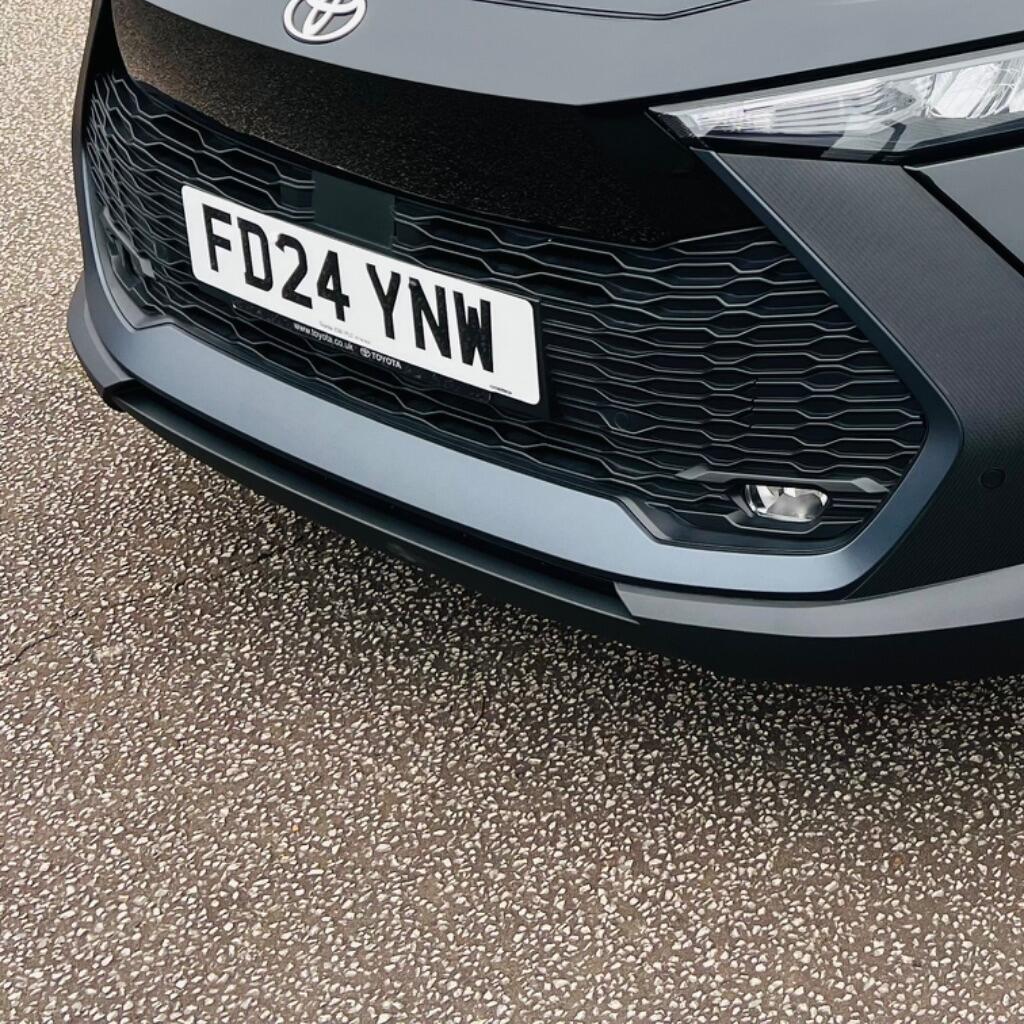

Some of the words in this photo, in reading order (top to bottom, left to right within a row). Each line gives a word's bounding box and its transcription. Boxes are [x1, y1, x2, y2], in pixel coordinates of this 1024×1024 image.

[202, 203, 350, 322] FD24
[366, 262, 494, 373] YNW
[293, 322, 354, 352] www.toyota.co.uk
[371, 351, 402, 369] TOYOTA
